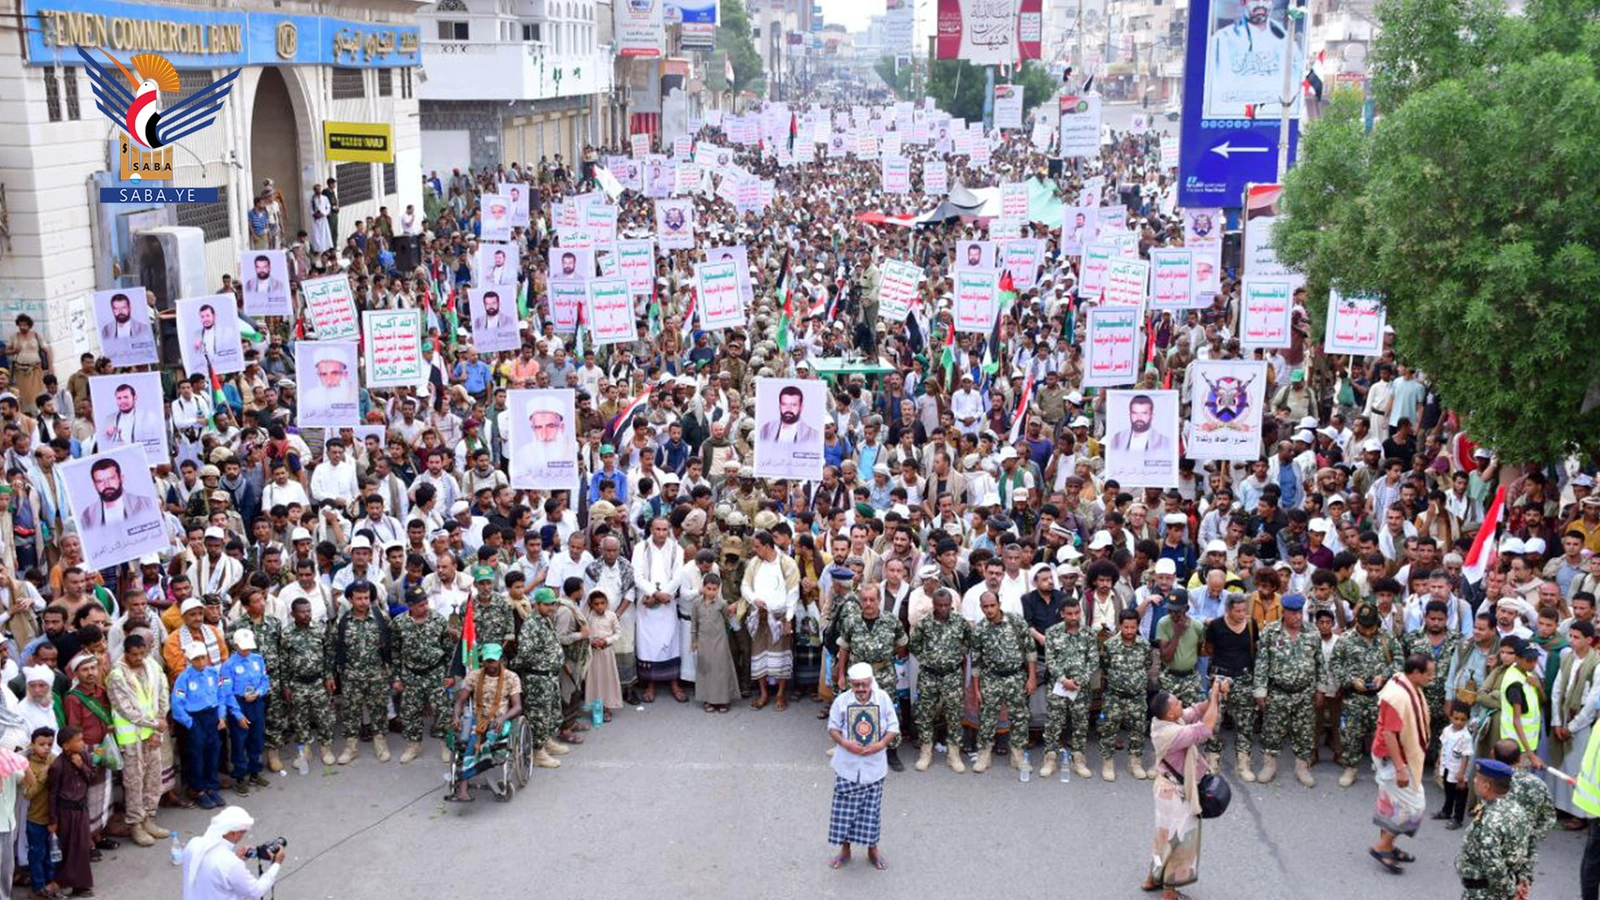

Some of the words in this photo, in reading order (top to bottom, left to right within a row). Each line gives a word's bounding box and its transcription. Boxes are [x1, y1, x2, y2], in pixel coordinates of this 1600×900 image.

[39, 10, 107, 47] YEMEN
[108, 17, 208, 54] COMMERCIAL
[208, 24, 242, 55] BANK
